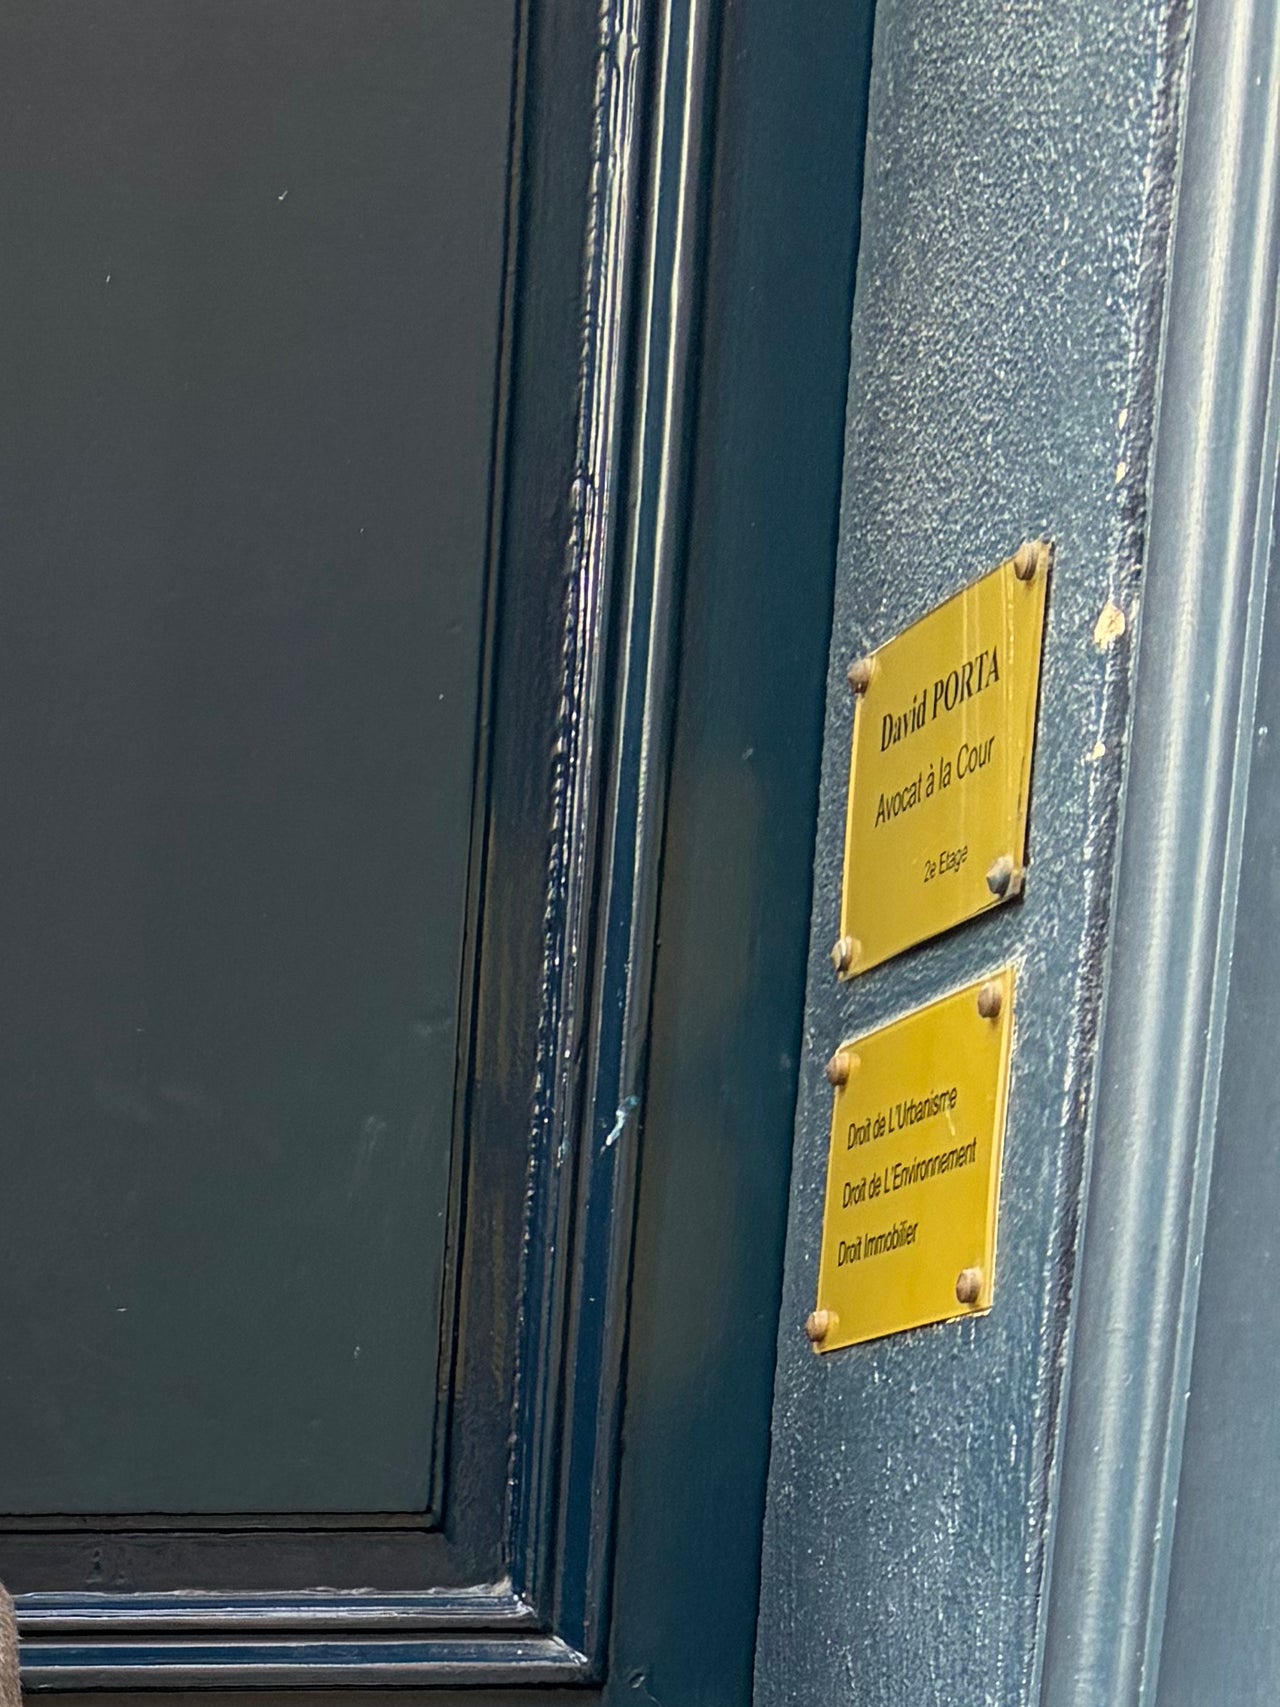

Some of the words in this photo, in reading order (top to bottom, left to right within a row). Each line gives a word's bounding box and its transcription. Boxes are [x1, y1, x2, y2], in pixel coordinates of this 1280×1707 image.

[880, 688, 928, 752] David
[931, 645, 1000, 721] PORTA
[874, 771, 923, 828] Avocat
[925, 763, 935, 798] à
[938, 756, 952, 791] la
[956, 735, 996, 780] Cour
[923, 859, 937, 883] 2e
[939, 845, 968, 875] Etage
[847, 1117, 872, 1151] Droit
[873, 1112, 886, 1140] de
[888, 1087, 958, 1134] L'Urbanisme
[842, 1176, 866, 1209] Droit
[868, 1172, 881, 1200] de
[883, 1137, 978, 1195] L'Environnement
[837, 1235, 862, 1267] Droit
[864, 1219, 919, 1259] Immobilier
